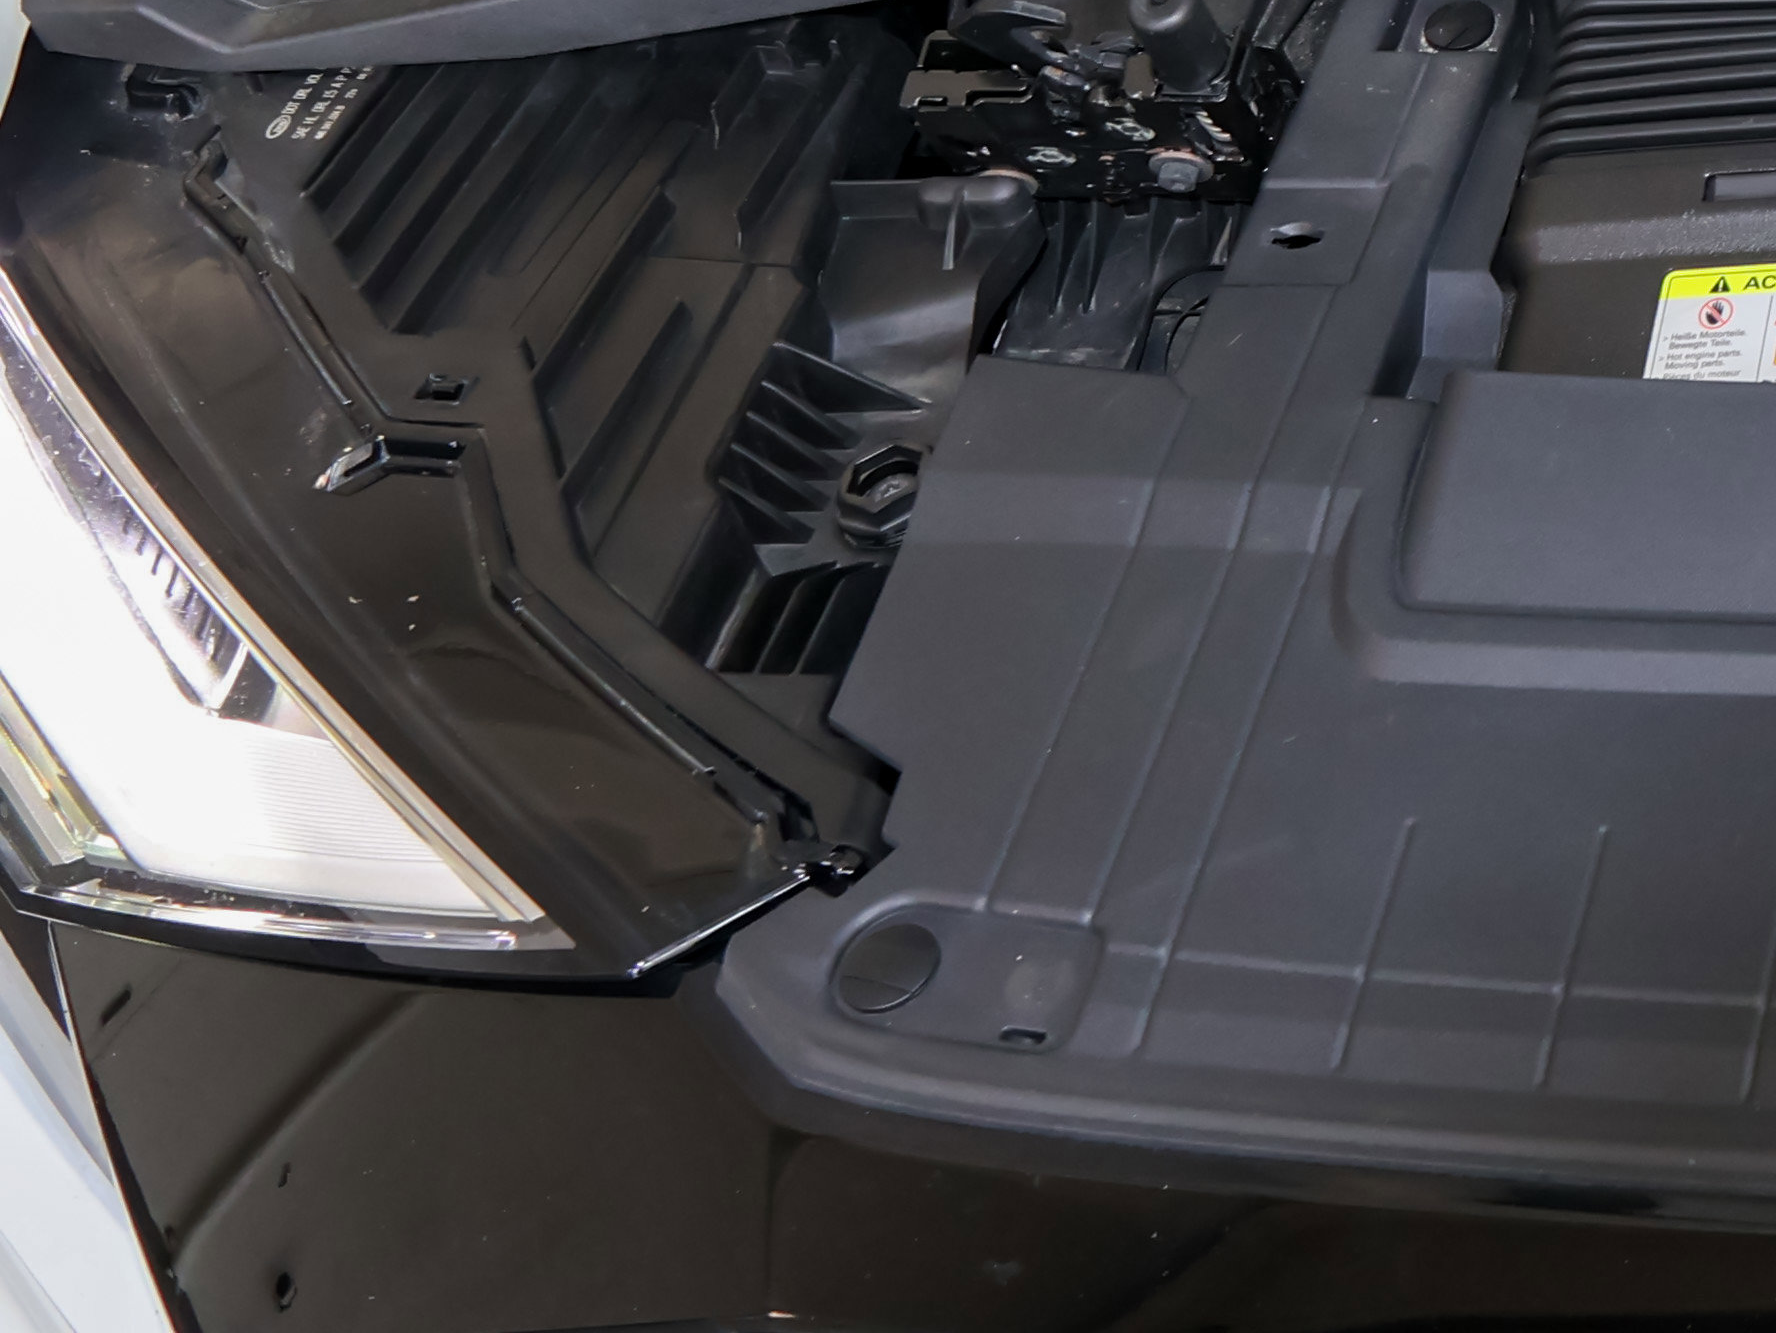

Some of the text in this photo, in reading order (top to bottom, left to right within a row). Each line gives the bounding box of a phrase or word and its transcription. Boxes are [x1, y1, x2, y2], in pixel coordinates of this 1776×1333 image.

[1668, 341, 1708, 351] Bewegte
[1666, 352, 1683, 361] Hot
[1684, 351, 1716, 361] engine
[1664, 361, 1699, 371] Moving
[1692, 369, 1742, 380] du moteur
